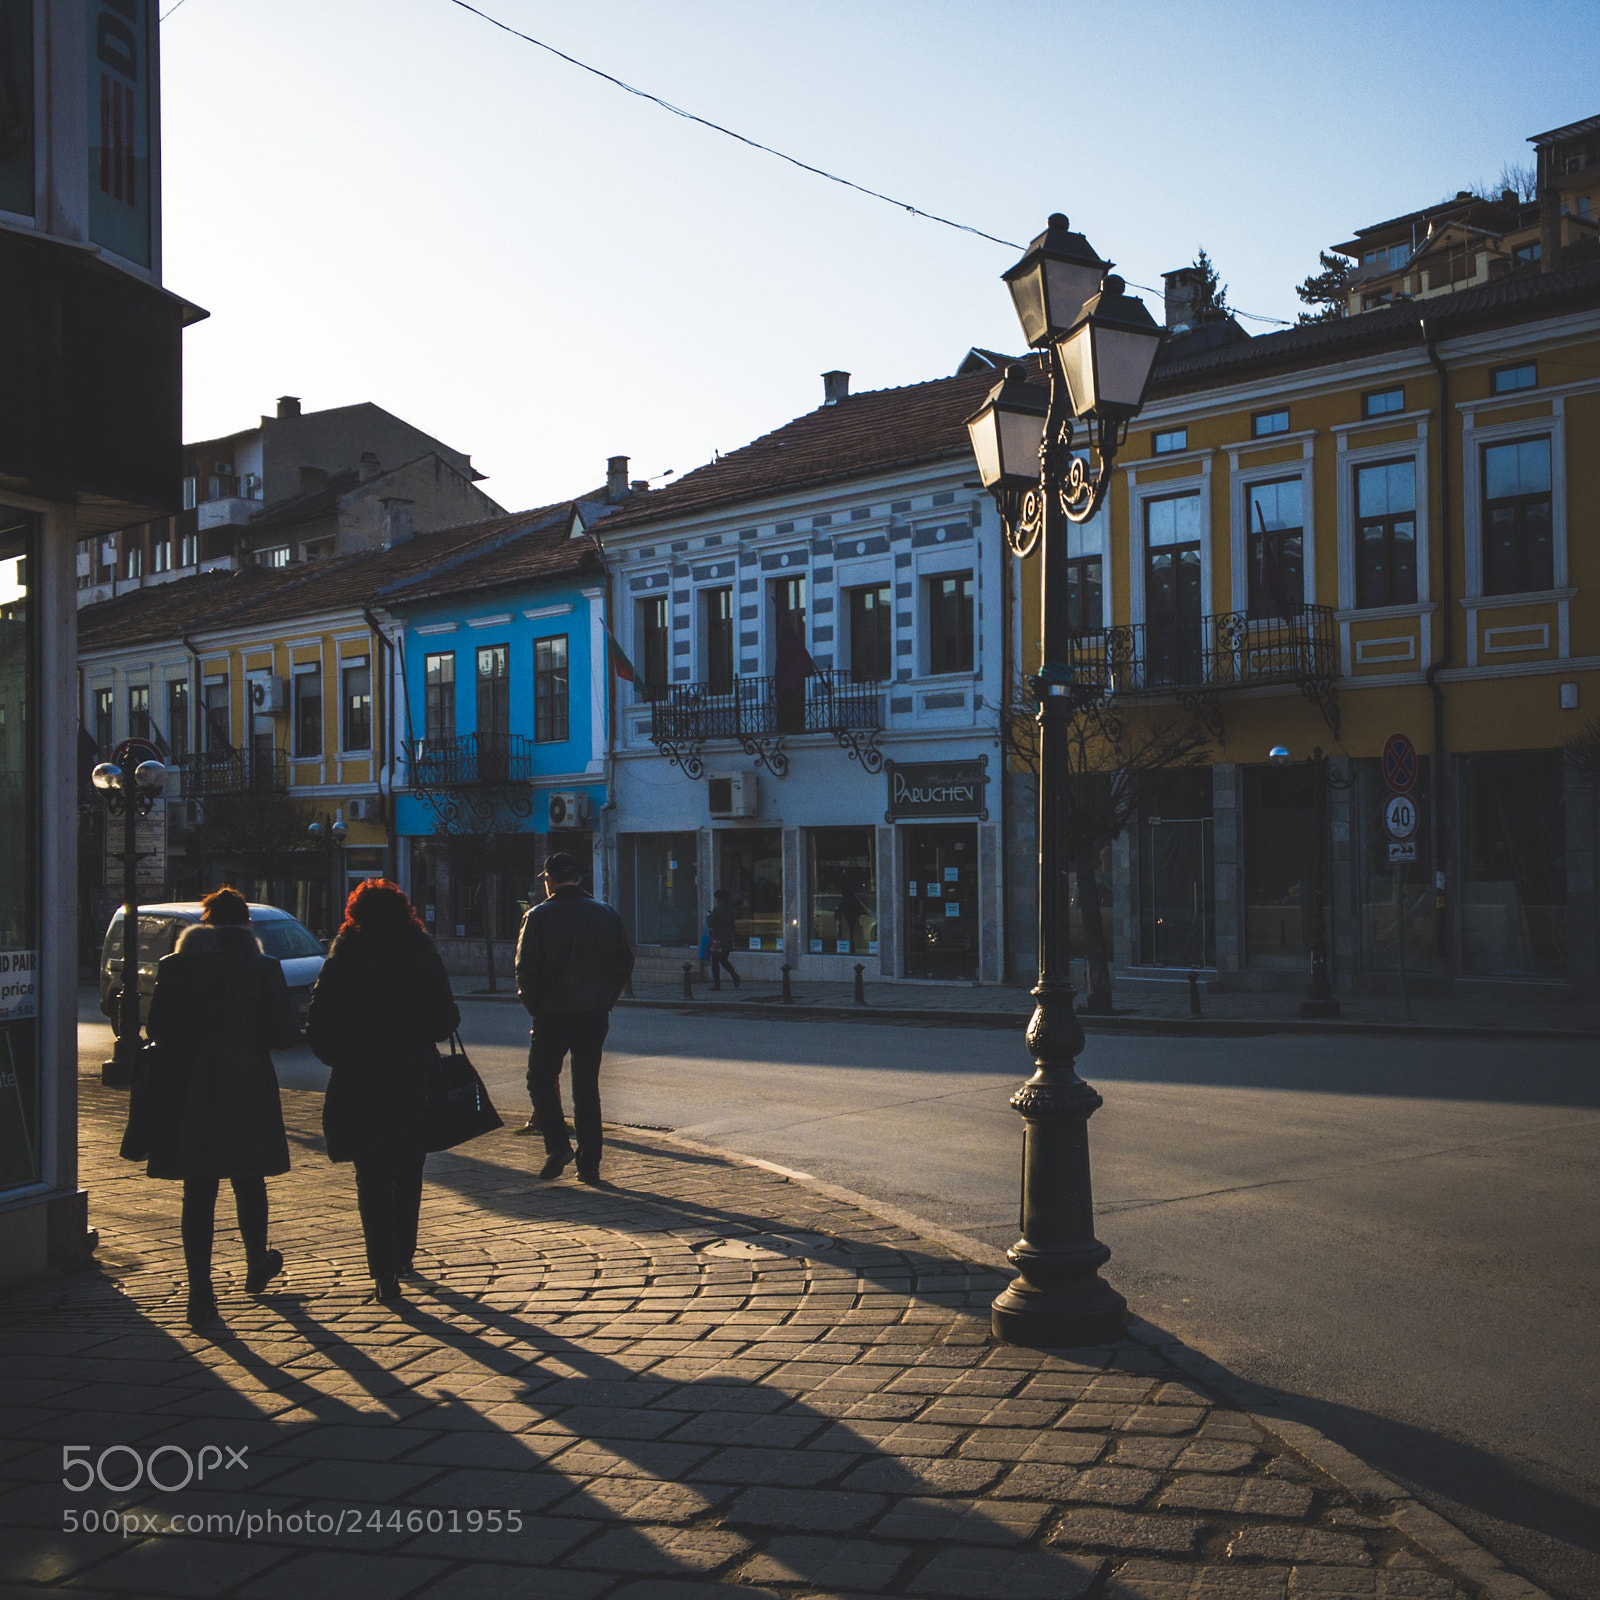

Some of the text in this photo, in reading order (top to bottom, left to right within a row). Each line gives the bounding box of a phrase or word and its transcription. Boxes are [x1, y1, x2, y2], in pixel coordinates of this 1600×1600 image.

[1391, 806, 1410, 827] 40
[12, 953, 36, 971] PAIR
[1, 981, 35, 1000] price
